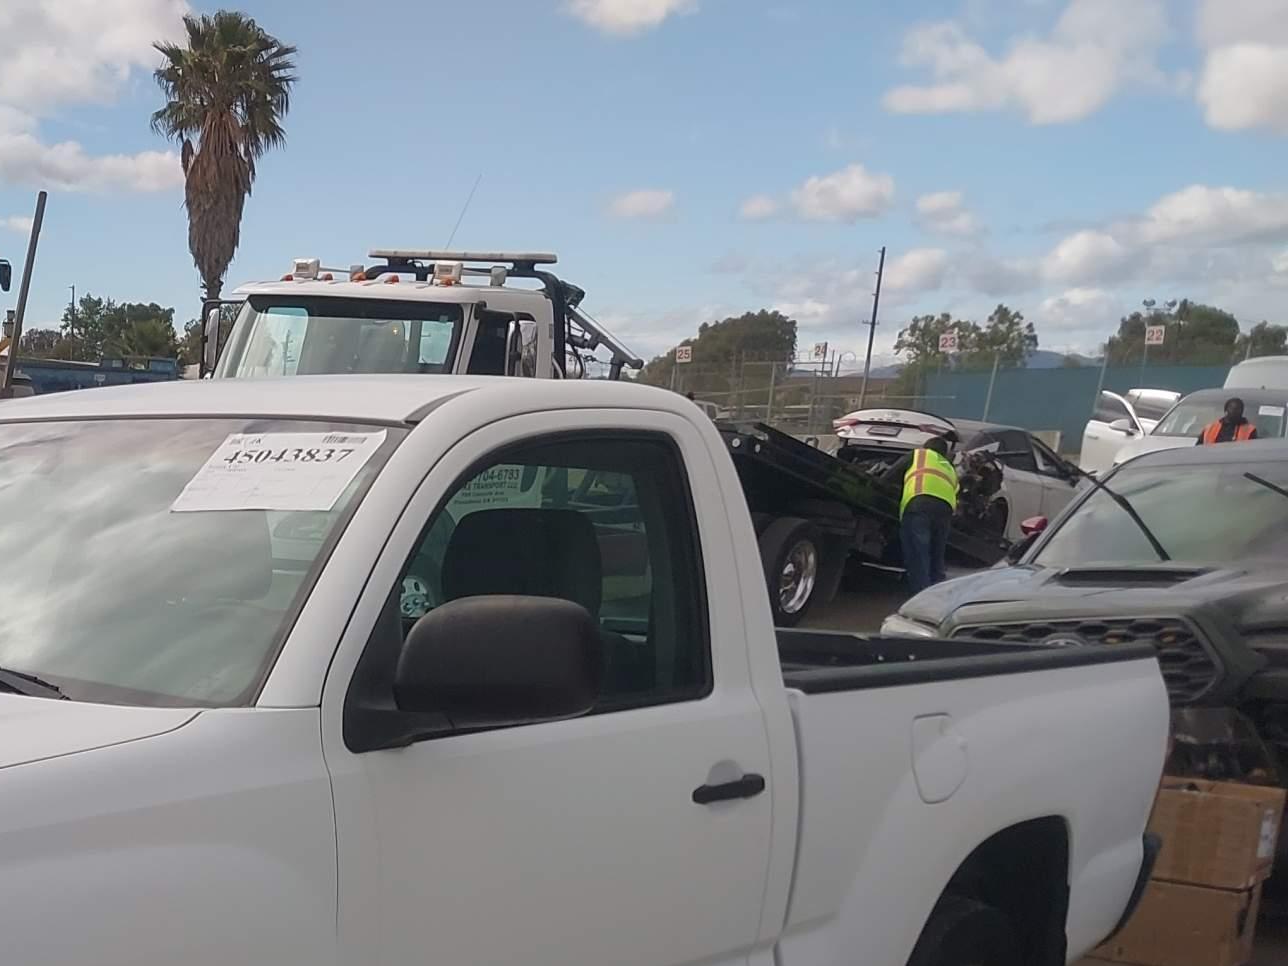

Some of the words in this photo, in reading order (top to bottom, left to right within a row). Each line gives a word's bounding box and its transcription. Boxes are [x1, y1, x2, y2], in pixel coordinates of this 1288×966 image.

[940, 336, 956, 348] 23
[678, 349, 690, 359] 25
[224, 448, 355, 464] 45043837
